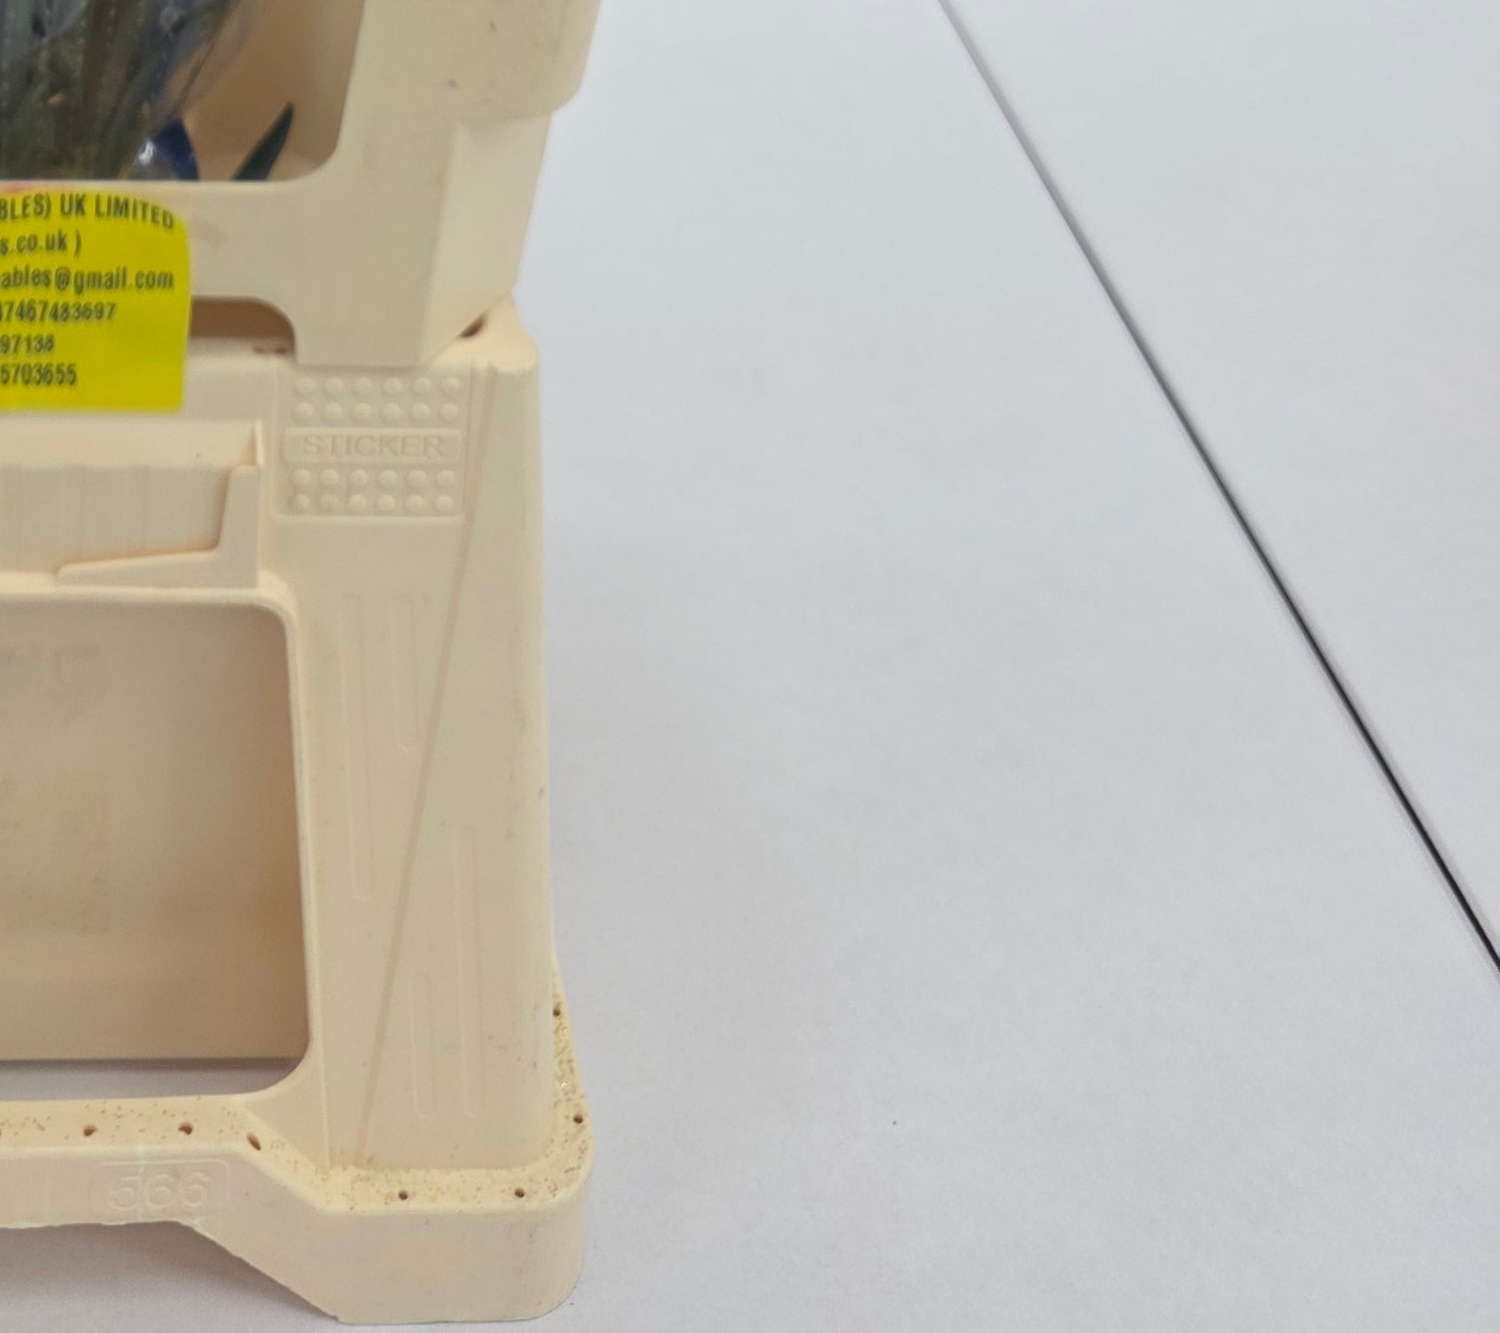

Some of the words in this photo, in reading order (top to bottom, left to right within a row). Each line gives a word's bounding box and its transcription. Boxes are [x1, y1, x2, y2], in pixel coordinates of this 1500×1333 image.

[60, 192, 87, 217] UK
[95, 194, 175, 230] LIMITED
[303, 434, 445, 458] STICKER
